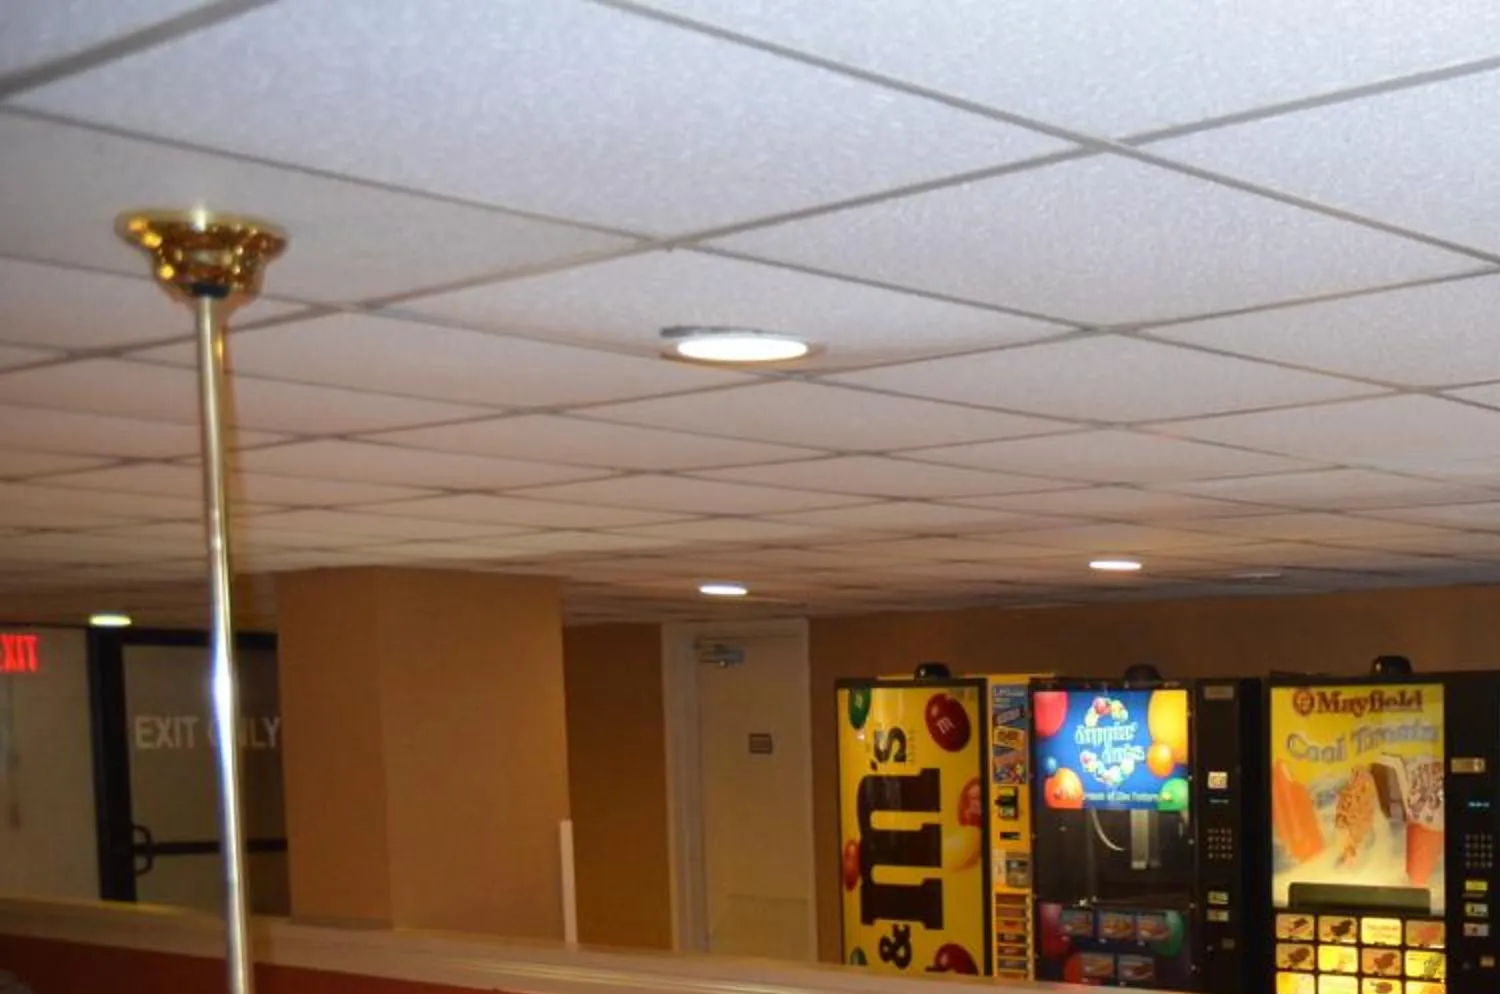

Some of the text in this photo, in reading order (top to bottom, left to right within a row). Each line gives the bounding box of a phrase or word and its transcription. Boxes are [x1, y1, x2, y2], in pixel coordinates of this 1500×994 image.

[0, 633, 37, 672] XIT
[1317, 690, 1424, 717] Mayfield
[134, 715, 280, 749] EXIT LY
